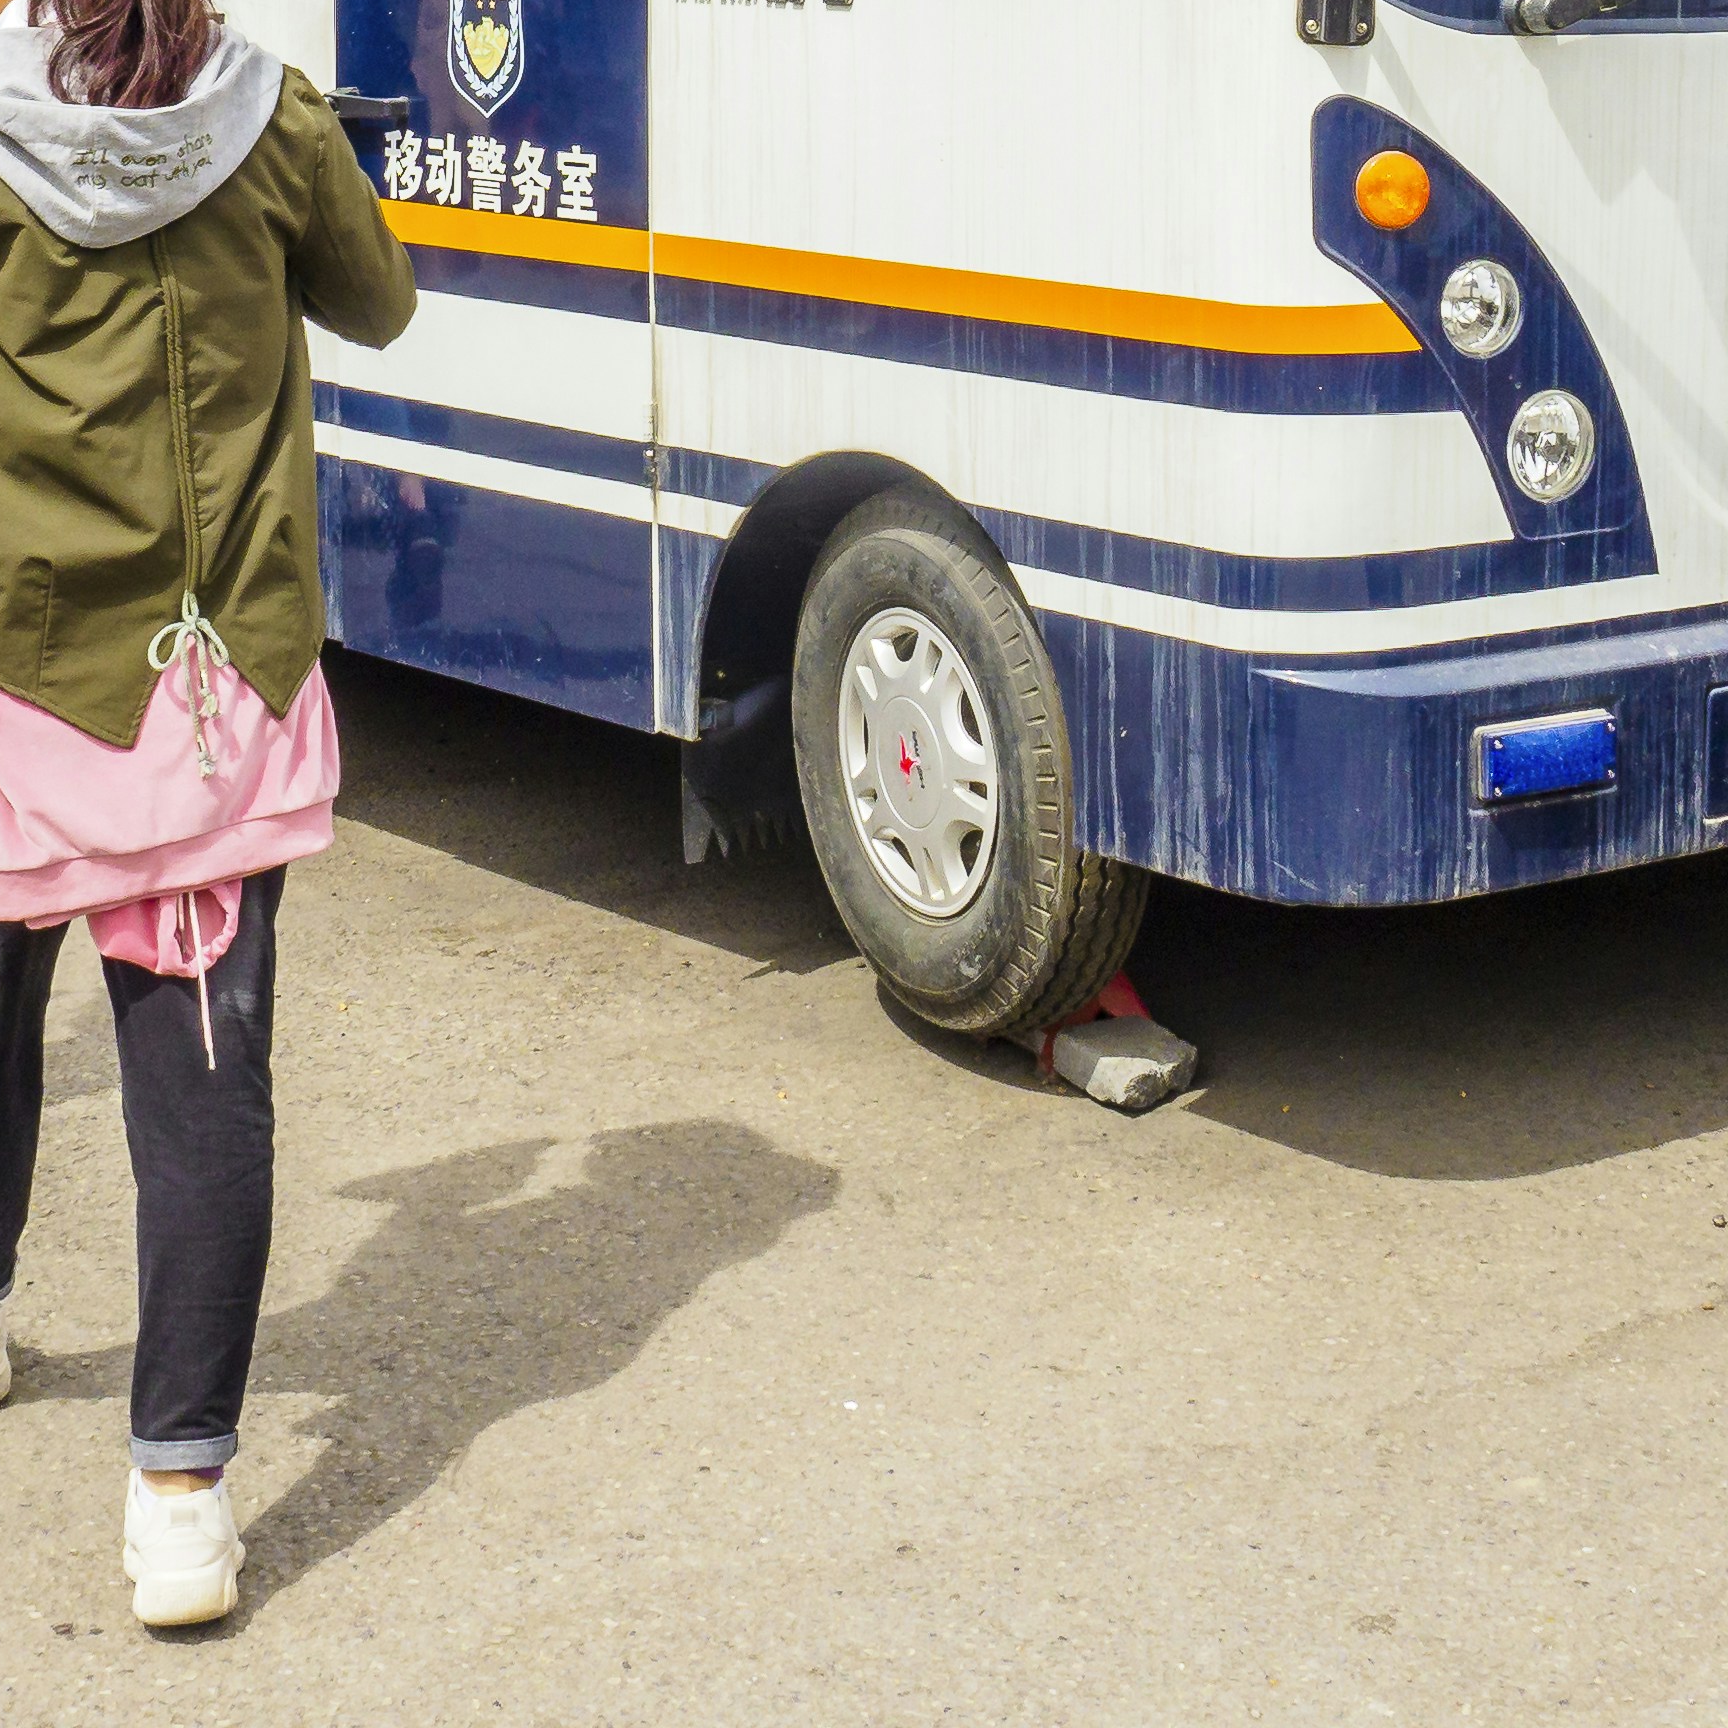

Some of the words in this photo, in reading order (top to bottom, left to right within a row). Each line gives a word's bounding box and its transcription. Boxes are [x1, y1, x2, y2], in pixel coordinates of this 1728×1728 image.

[384, 129, 599, 221] 移动警务室
